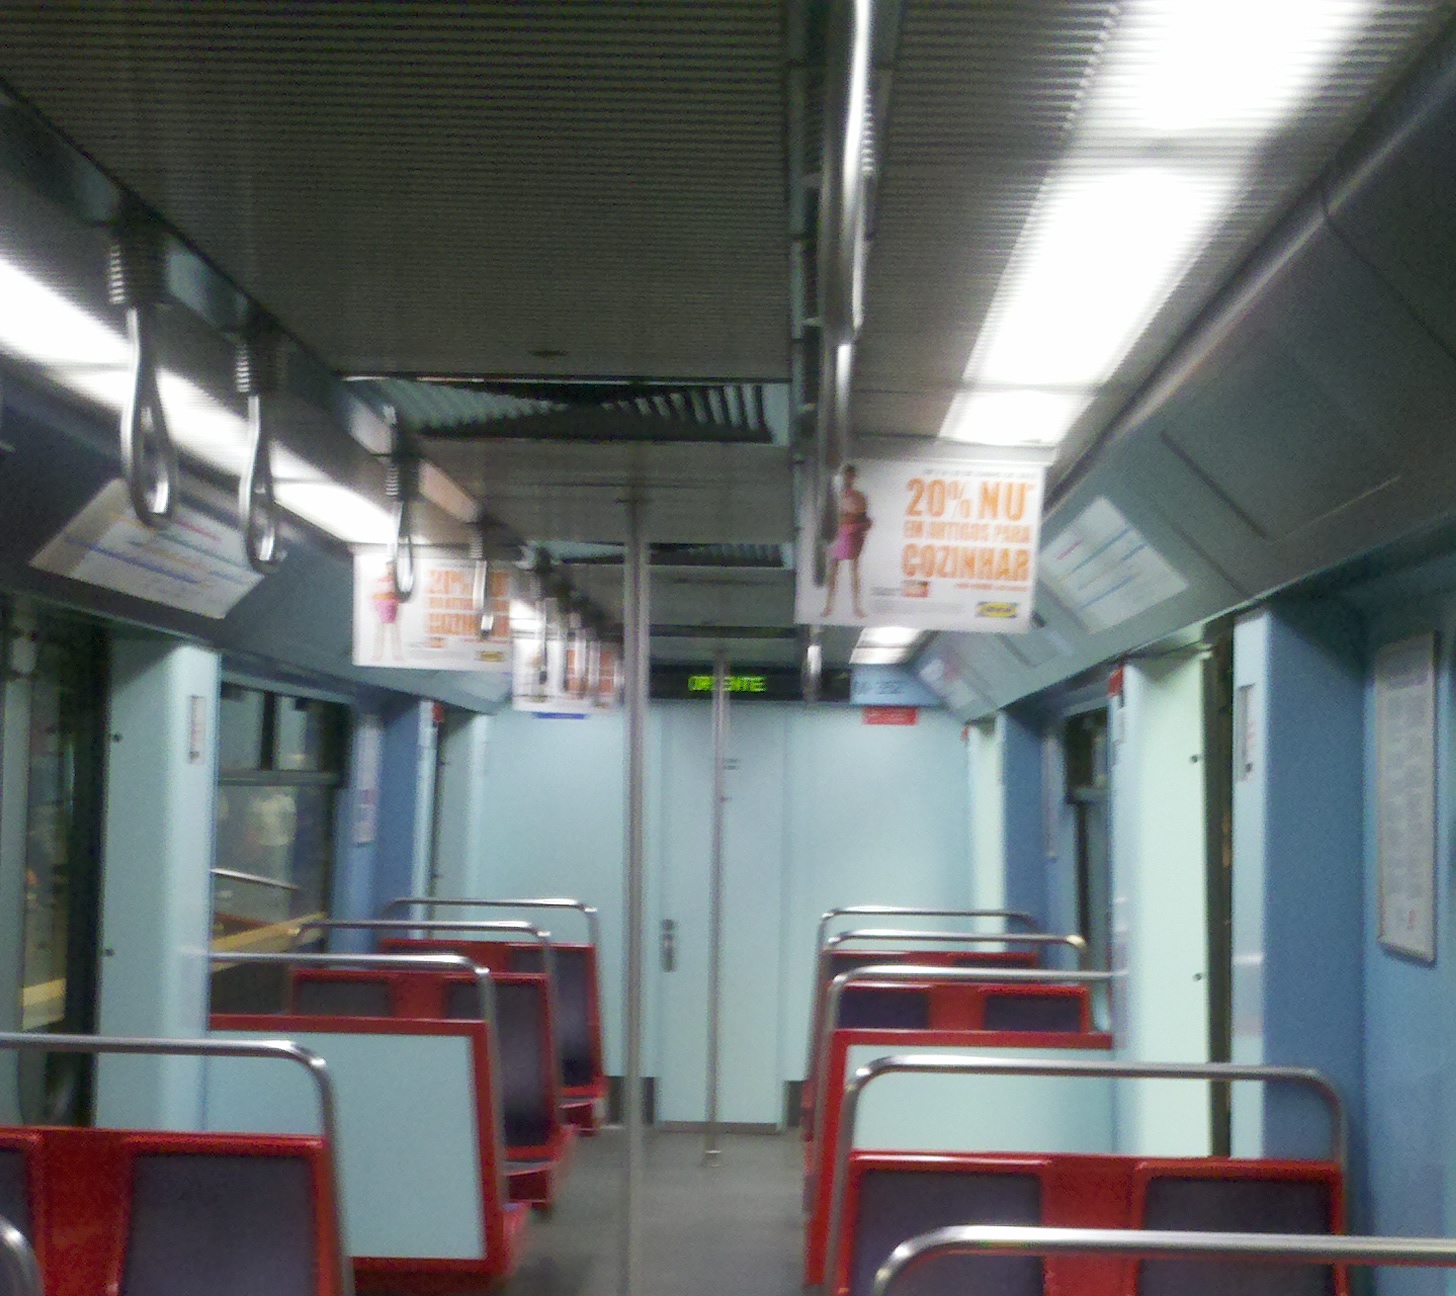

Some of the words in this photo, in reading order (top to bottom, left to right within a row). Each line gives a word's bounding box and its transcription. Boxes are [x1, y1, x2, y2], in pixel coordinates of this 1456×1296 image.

[905, 478, 971, 519] 20%
[902, 542, 1030, 581] COZINHAR
[687, 675, 767, 692] ORENTE
